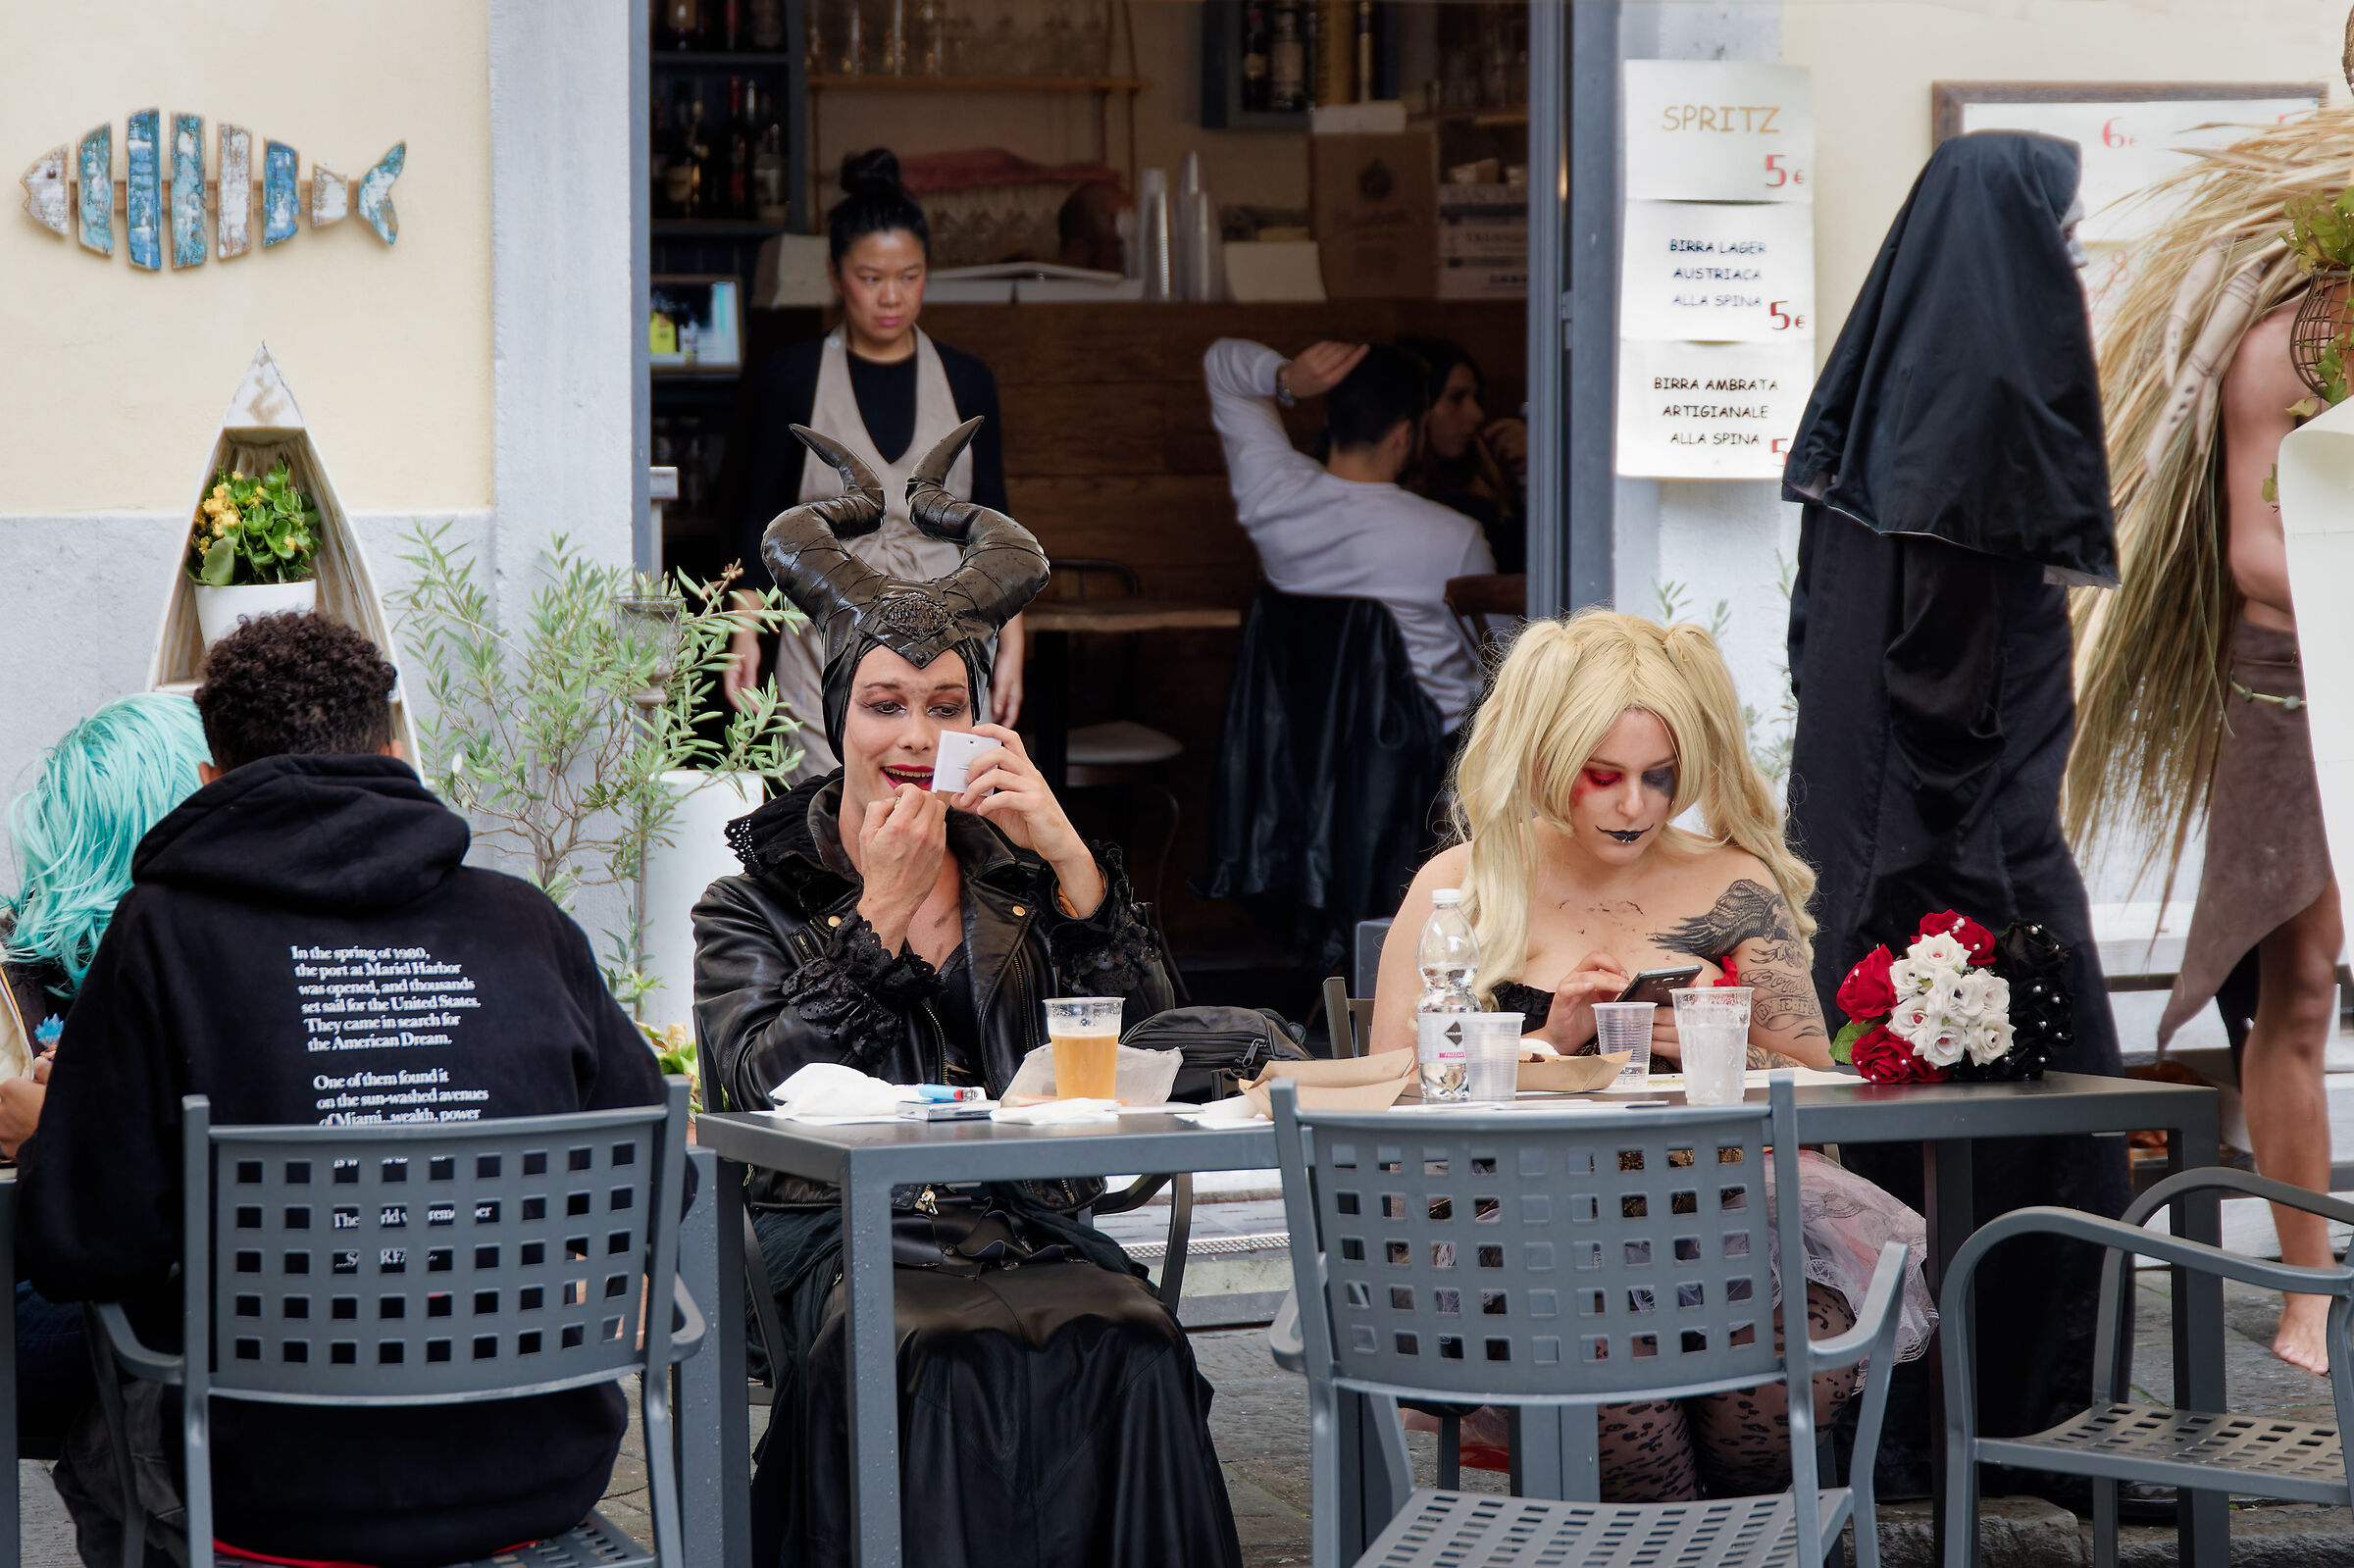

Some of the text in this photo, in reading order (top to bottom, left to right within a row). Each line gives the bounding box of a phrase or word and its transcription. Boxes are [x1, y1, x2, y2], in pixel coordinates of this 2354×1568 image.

[1662, 104, 1780, 133] SPRITZ
[1669, 238, 1766, 254] BIRRA LAGER
[1673, 267, 1763, 280] AUSTRIACA
[1672, 294, 1763, 307] ALLA SPINA
[1654, 377, 1779, 391] BIRRA AMBRATA
[1662, 404, 1769, 419] ARTIGIANALE
[1670, 432, 1761, 445] ALLA SPINA
[290, 945, 309, 960] In
[309, 945, 333, 960] the
[333, 944, 377, 963] spring
[377, 946, 392, 960] of
[294, 961, 462, 982] the port at Mariel Harbor
[297, 977, 476, 998] was opened, and thousands
[300, 1001, 322, 1015] set
[321, 997, 346, 1013] sail
[346, 997, 367, 1013] for
[367, 997, 390, 1013] the
[389, 995, 438, 1012] United
[303, 1011, 462, 1036] They came in search for
[307, 1032, 453, 1053] the American Dream.
[313, 1068, 450, 1091] One of them found it
[316, 1087, 489, 1111] on the sun-washed avenues
[439, 1109, 482, 1123] power
